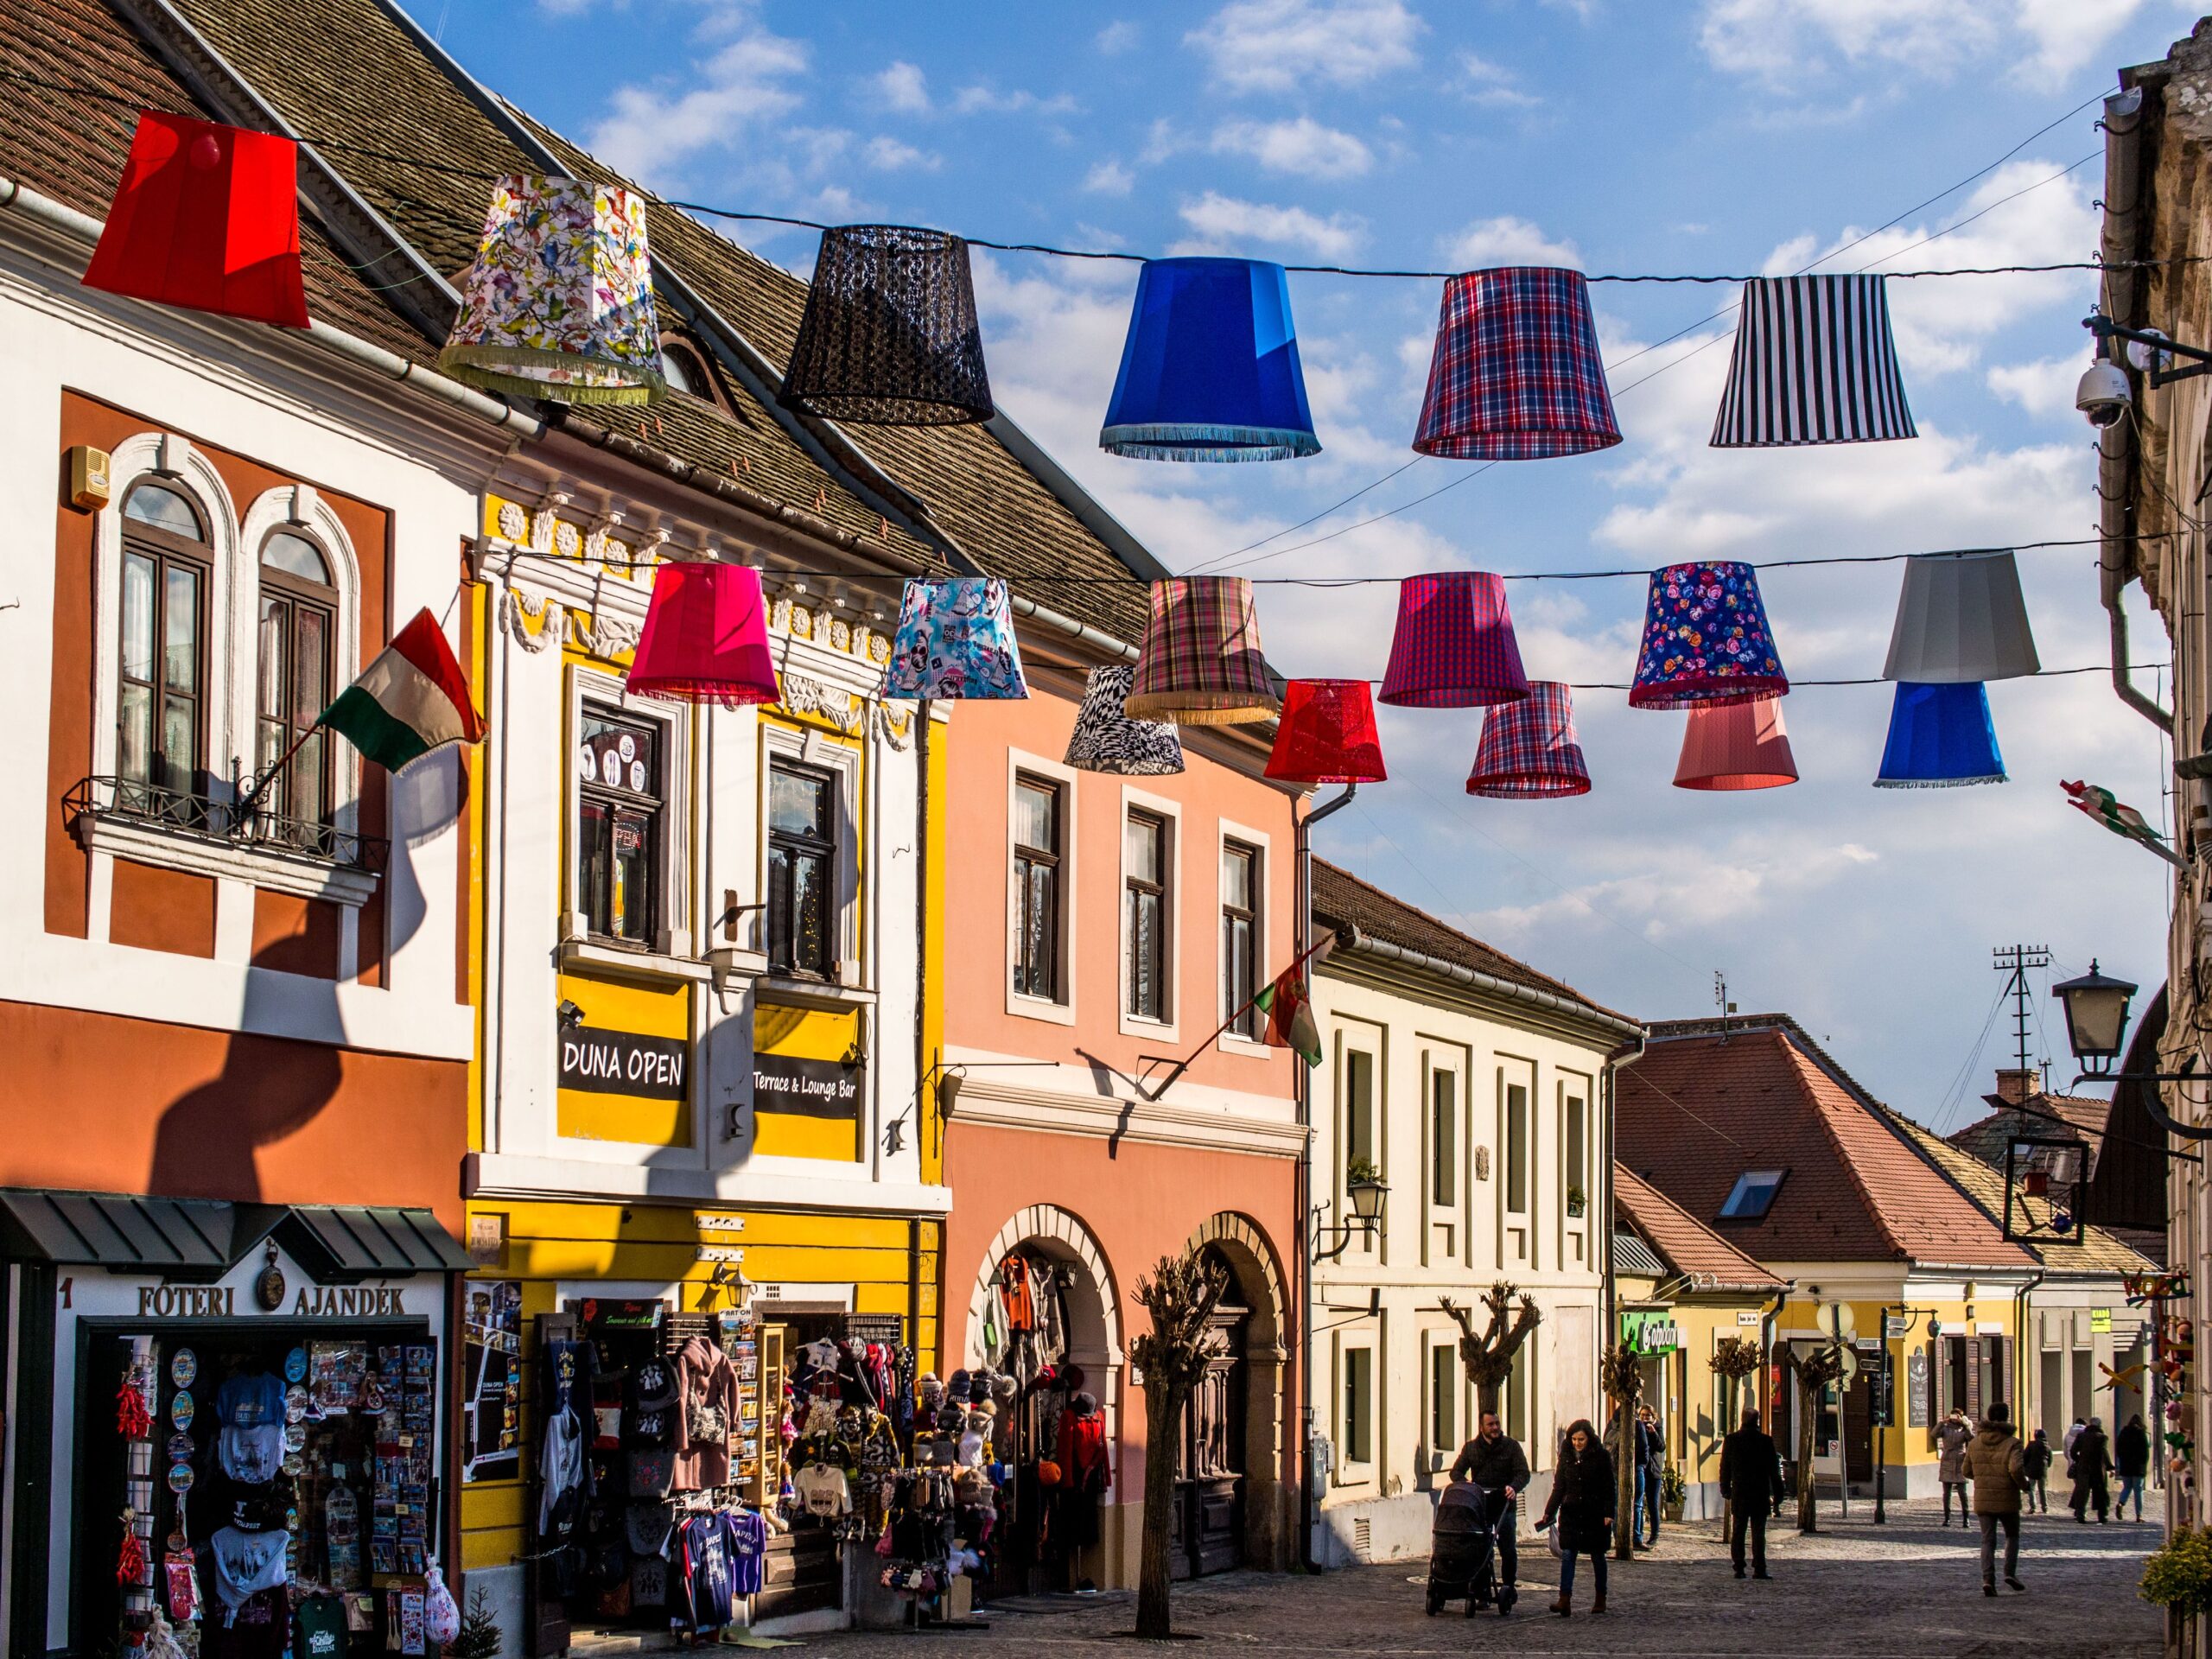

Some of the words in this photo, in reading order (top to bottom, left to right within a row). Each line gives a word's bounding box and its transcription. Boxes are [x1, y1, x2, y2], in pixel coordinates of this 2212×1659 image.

[563, 1042, 621, 1079] DUNA
[627, 1049, 682, 1086] OPEN
[753, 1071, 789, 1092] Terrace
[791, 1081, 799, 1093] &
[802, 1076, 836, 1102] Lounge
[839, 1079, 855, 1098] Bar
[58, 1277, 73, 1309] 1
